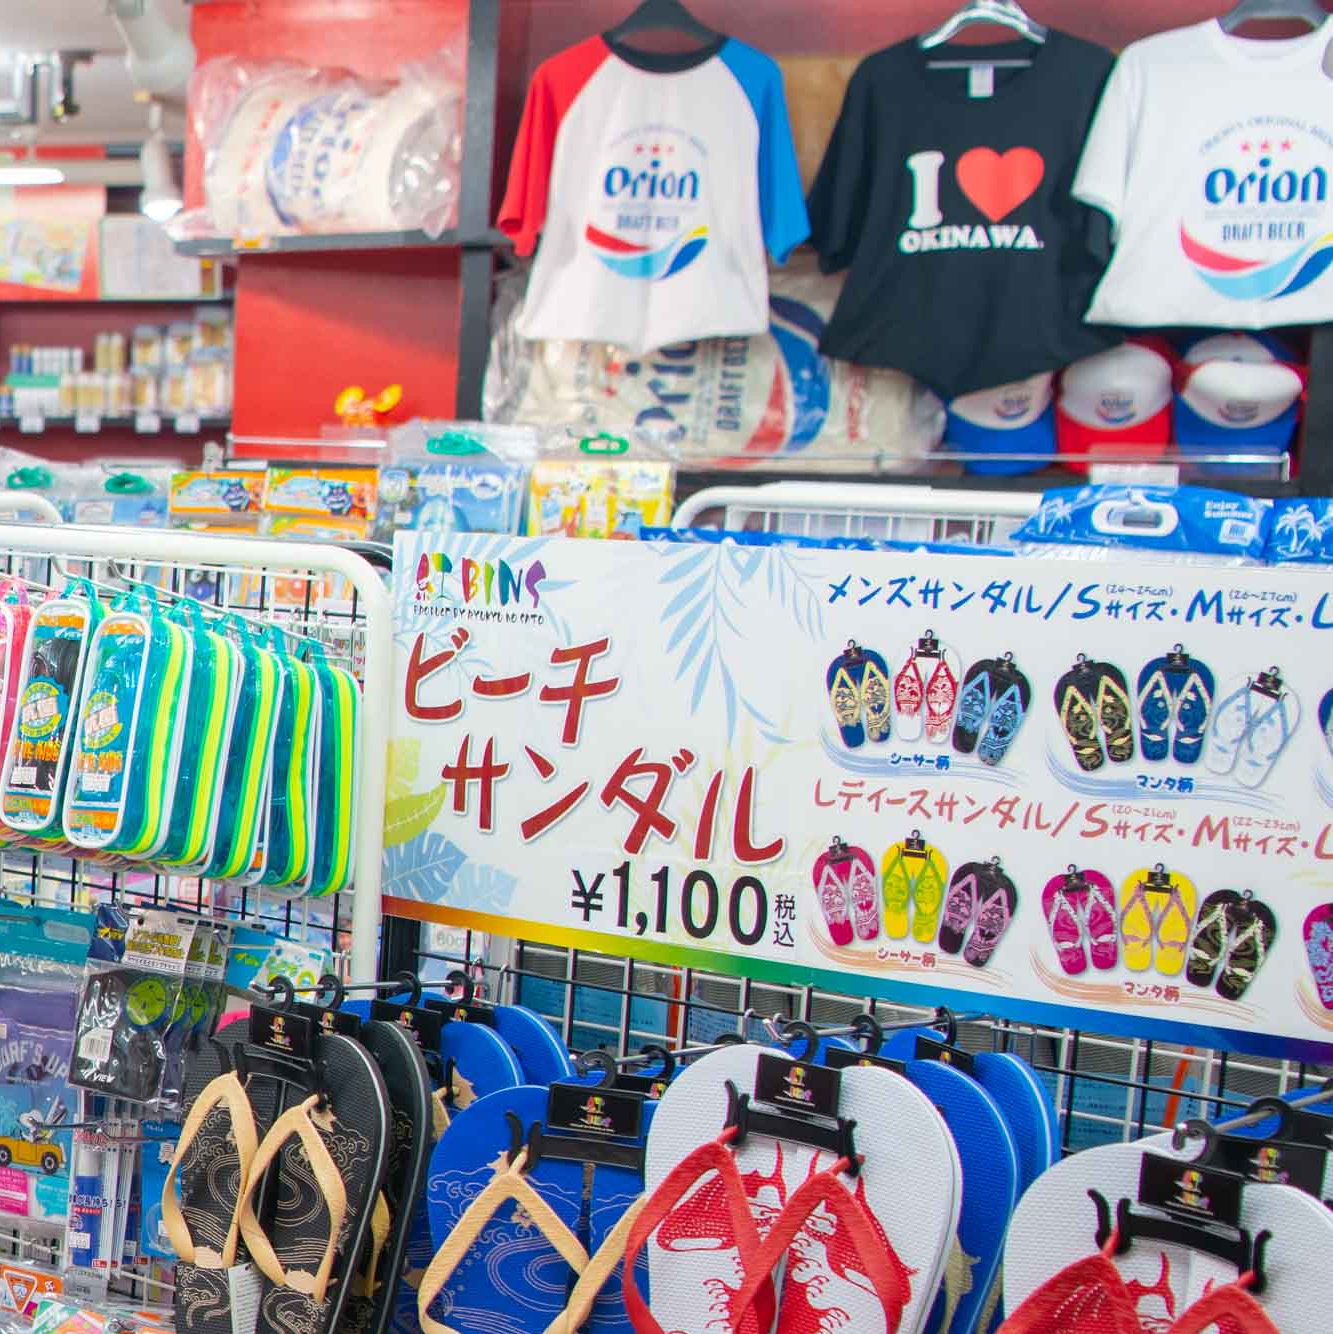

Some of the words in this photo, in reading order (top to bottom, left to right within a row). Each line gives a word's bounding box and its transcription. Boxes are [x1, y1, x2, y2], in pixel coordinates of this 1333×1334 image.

[604, 161, 698, 201] Orion
[906, 151, 944, 229] I
[1205, 157, 1327, 205] Orion
[1222, 222, 1263, 242] DRAFT
[1267, 221, 1305, 241] BEER
[405, 627, 621, 746] ビーチ
[890, 751, 950, 771] シーサー柄
[1136, 774, 1194, 794] マンタ柄
[440, 733, 785, 864] サンダル
[570, 860, 769, 947] ¥1,100
[773, 893, 796, 948] 税込
